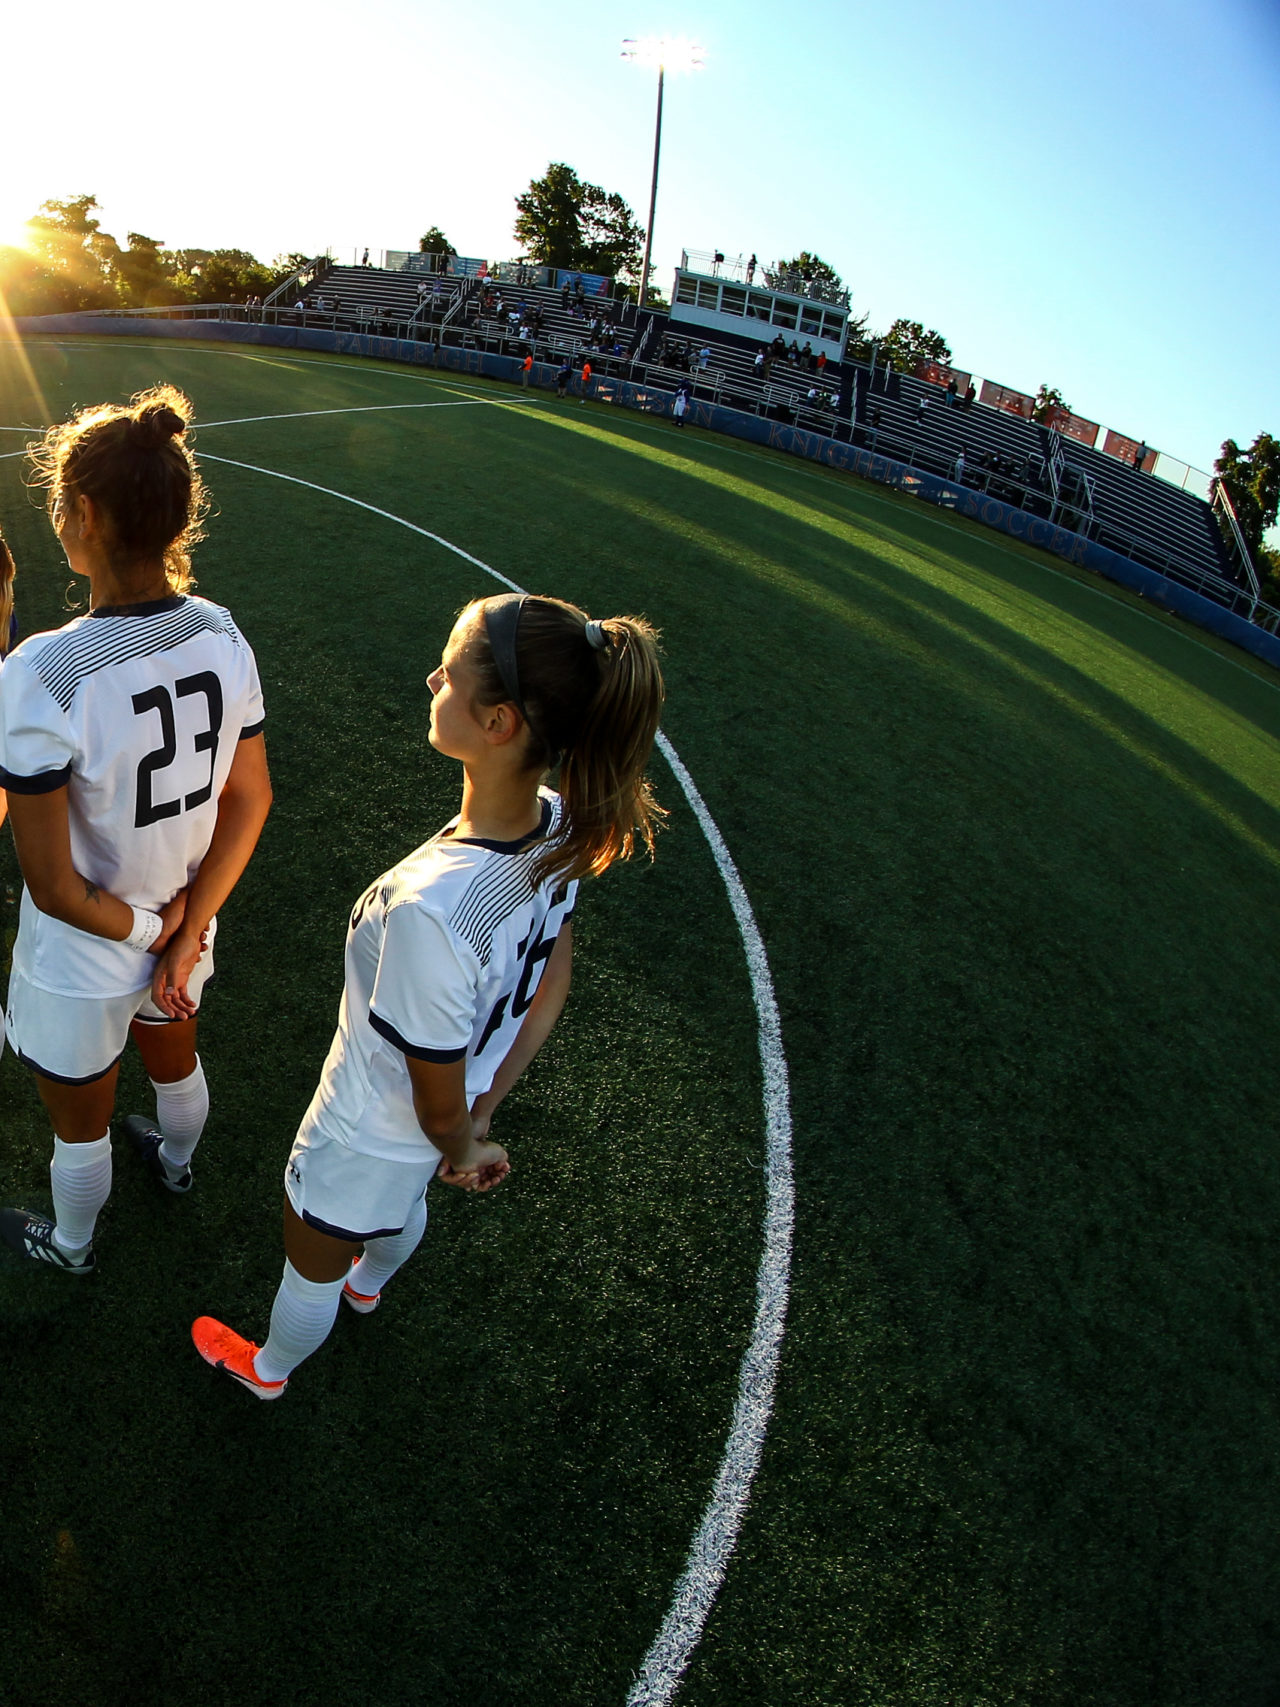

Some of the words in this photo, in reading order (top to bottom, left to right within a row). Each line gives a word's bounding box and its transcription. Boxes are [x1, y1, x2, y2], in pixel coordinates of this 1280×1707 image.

[334, 331, 484, 373] FAIRLEGH
[963, 491, 1089, 564] SOCCER
[131, 670, 223, 828] 23
